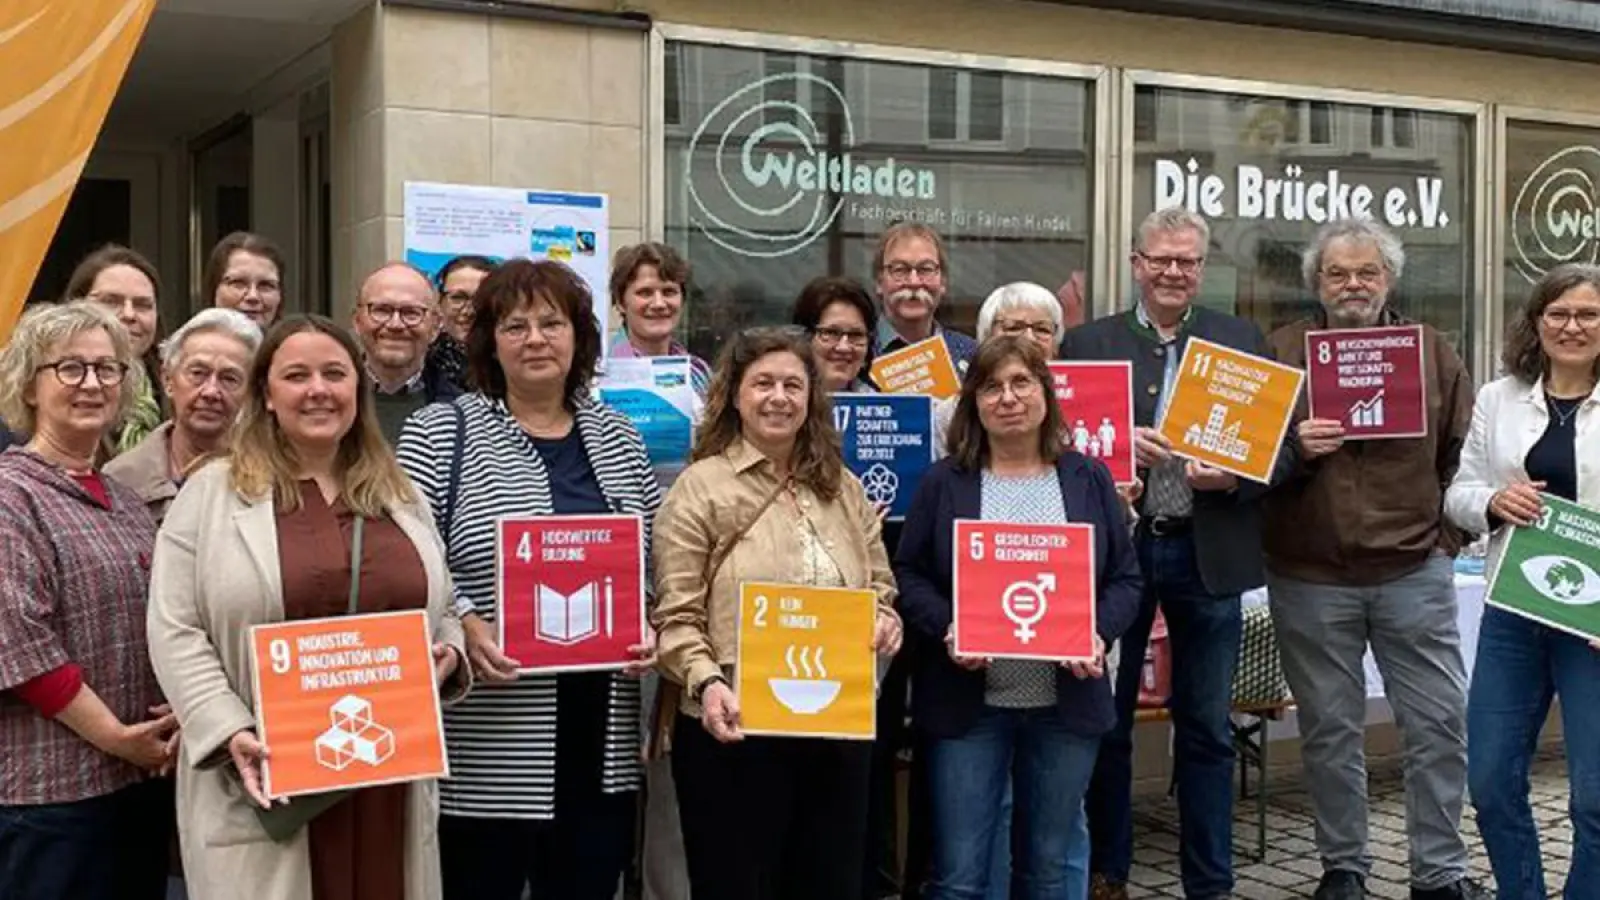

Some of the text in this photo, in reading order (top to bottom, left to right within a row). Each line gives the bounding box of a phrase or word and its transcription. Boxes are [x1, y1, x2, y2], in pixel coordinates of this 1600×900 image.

[741, 122, 936, 199] Weltladen
[1155, 156, 1450, 229] Die Brücke e.V.
[850, 202, 947, 225] Fachgeschäft
[952, 208, 971, 228] für
[1024, 214, 1073, 232] Handel
[1191, 352, 1212, 378] 11
[1318, 340, 1332, 365] 8
[832, 405, 851, 433] 17
[1530, 505, 1554, 531] 3
[515, 530, 533, 564] 4
[969, 531, 985, 561] 5
[753, 594, 769, 627] 2
[269, 638, 291, 674] 9
[298, 645, 400, 672] INNOVATION UND
[300, 664, 403, 692] INFRASTRUKTUR
